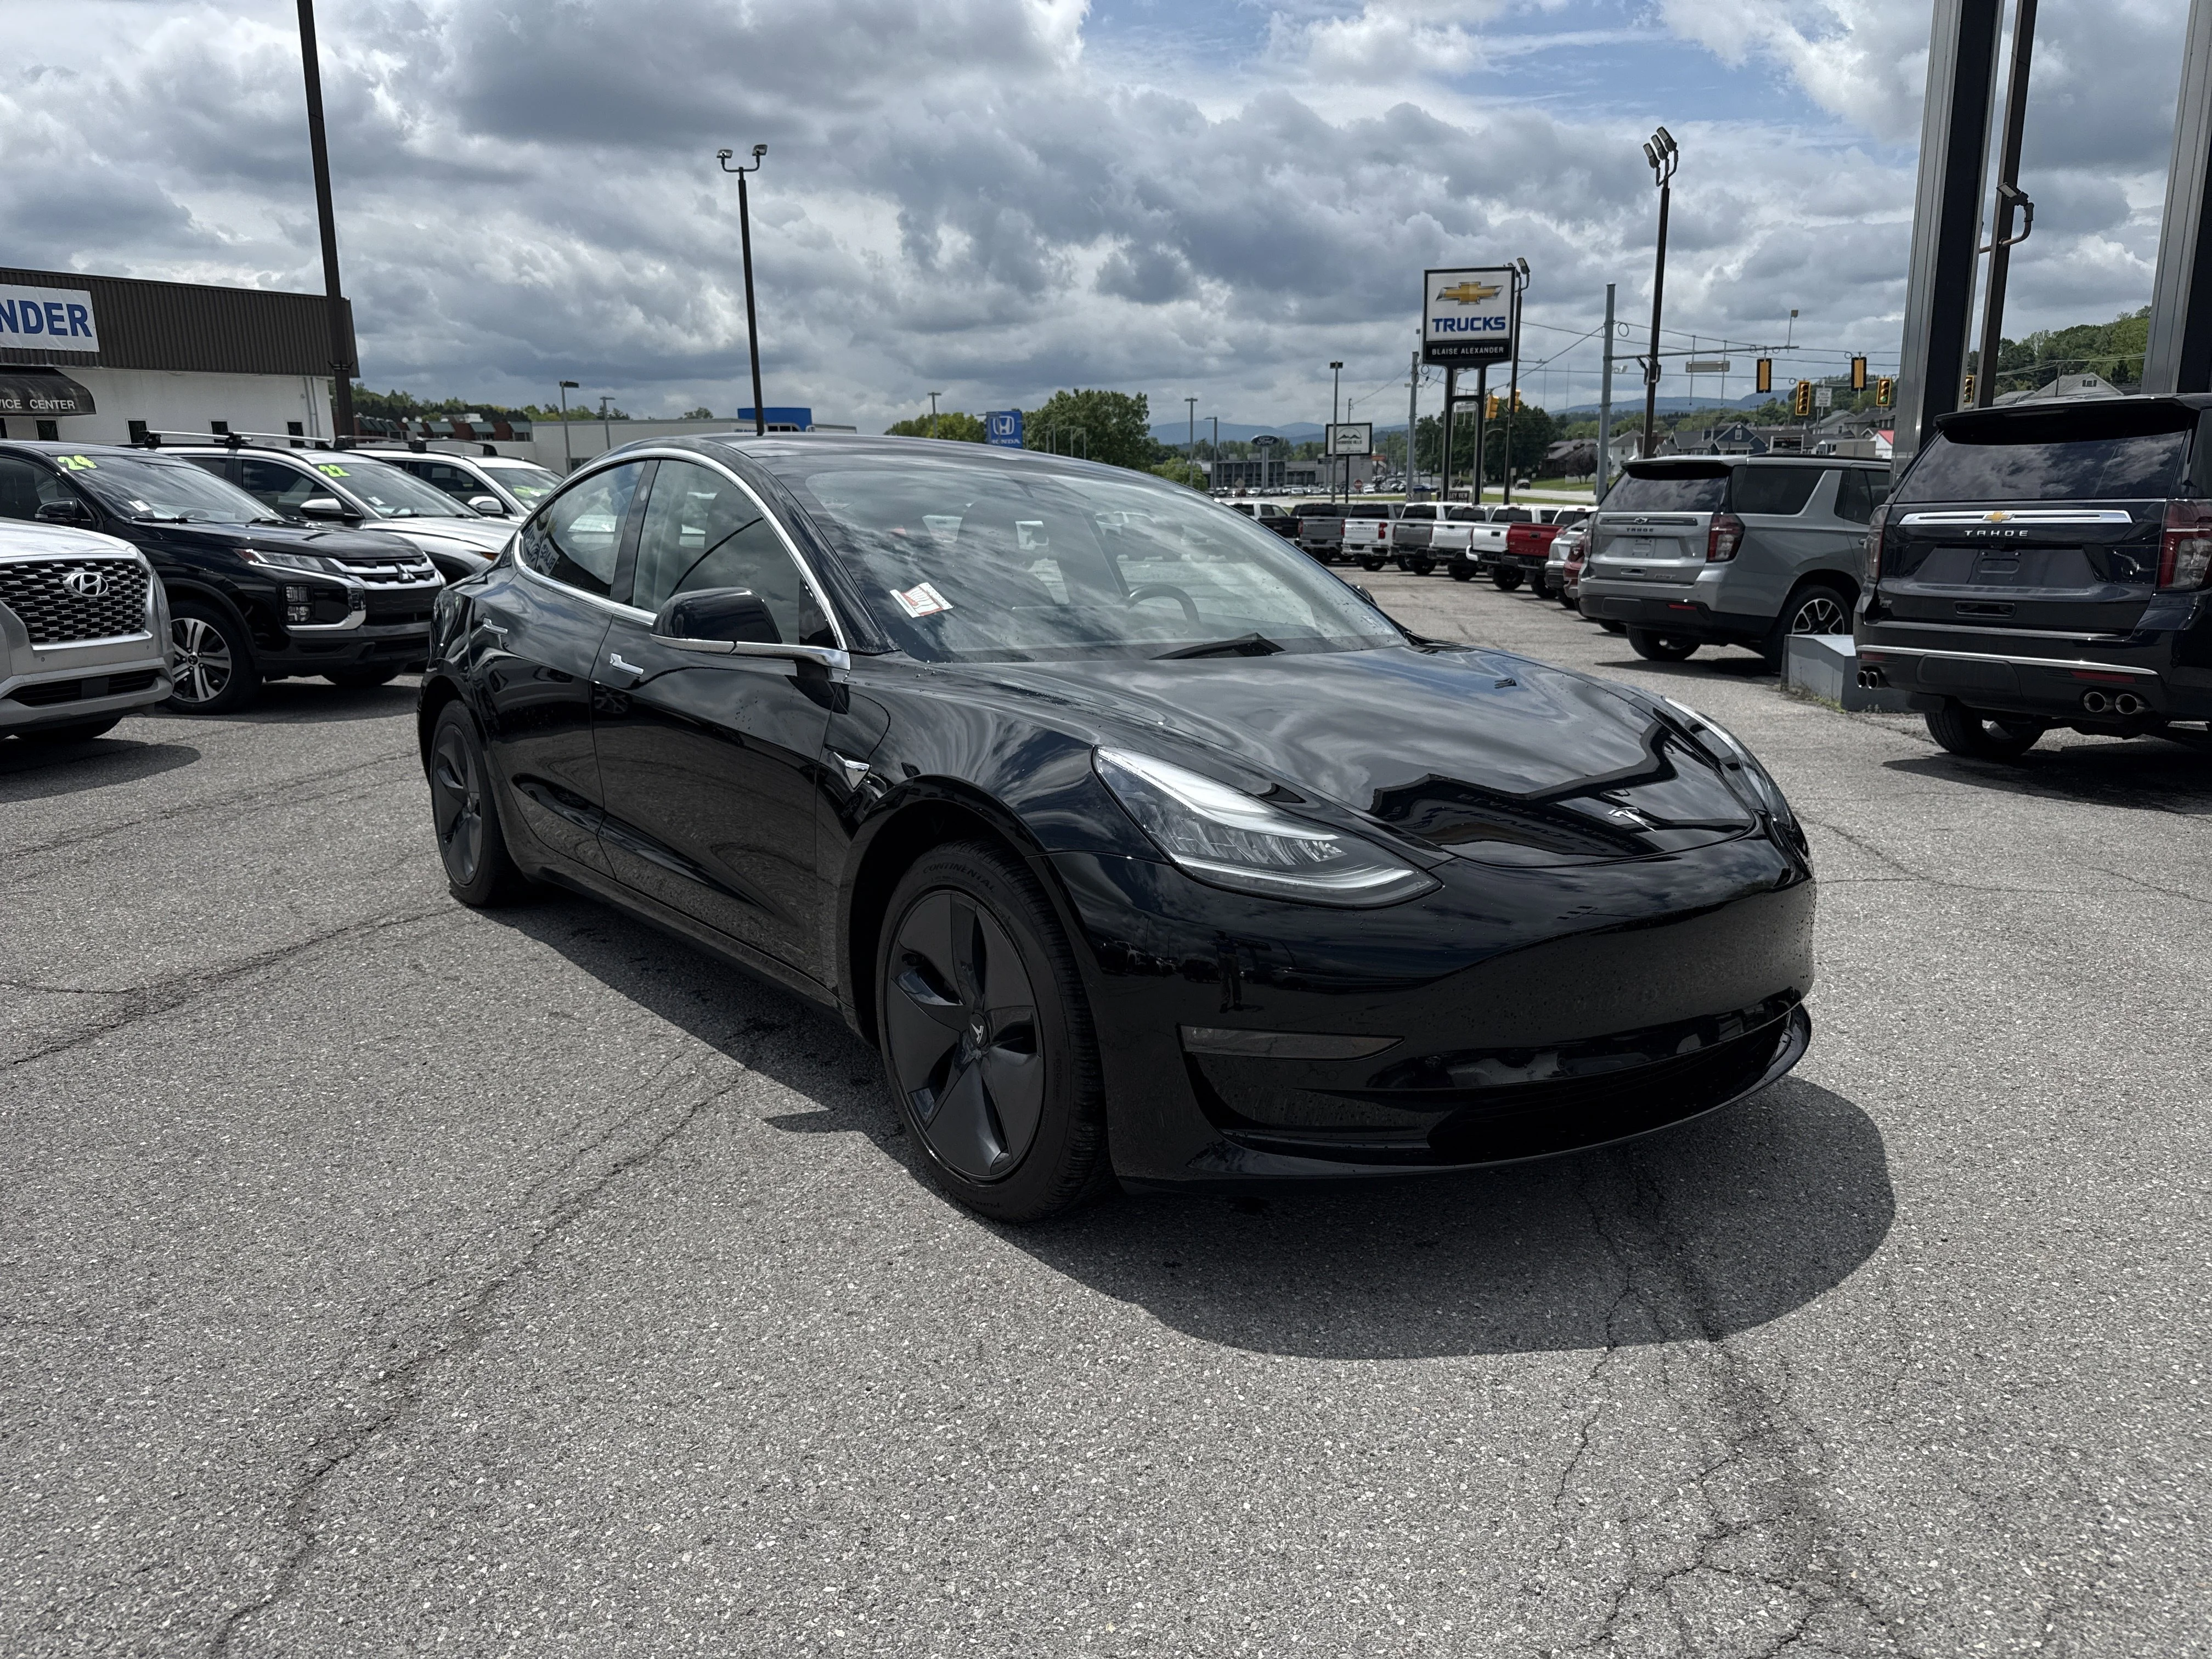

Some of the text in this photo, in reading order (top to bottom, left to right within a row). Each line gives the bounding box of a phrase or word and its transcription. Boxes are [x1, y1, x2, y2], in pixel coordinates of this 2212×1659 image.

[1432, 317, 1506, 332] TRUCKS
[0, 399, 76, 410] ICE CENTER
[318, 464, 351, 477] 22
[922, 862, 996, 893] CONTINENTAL
